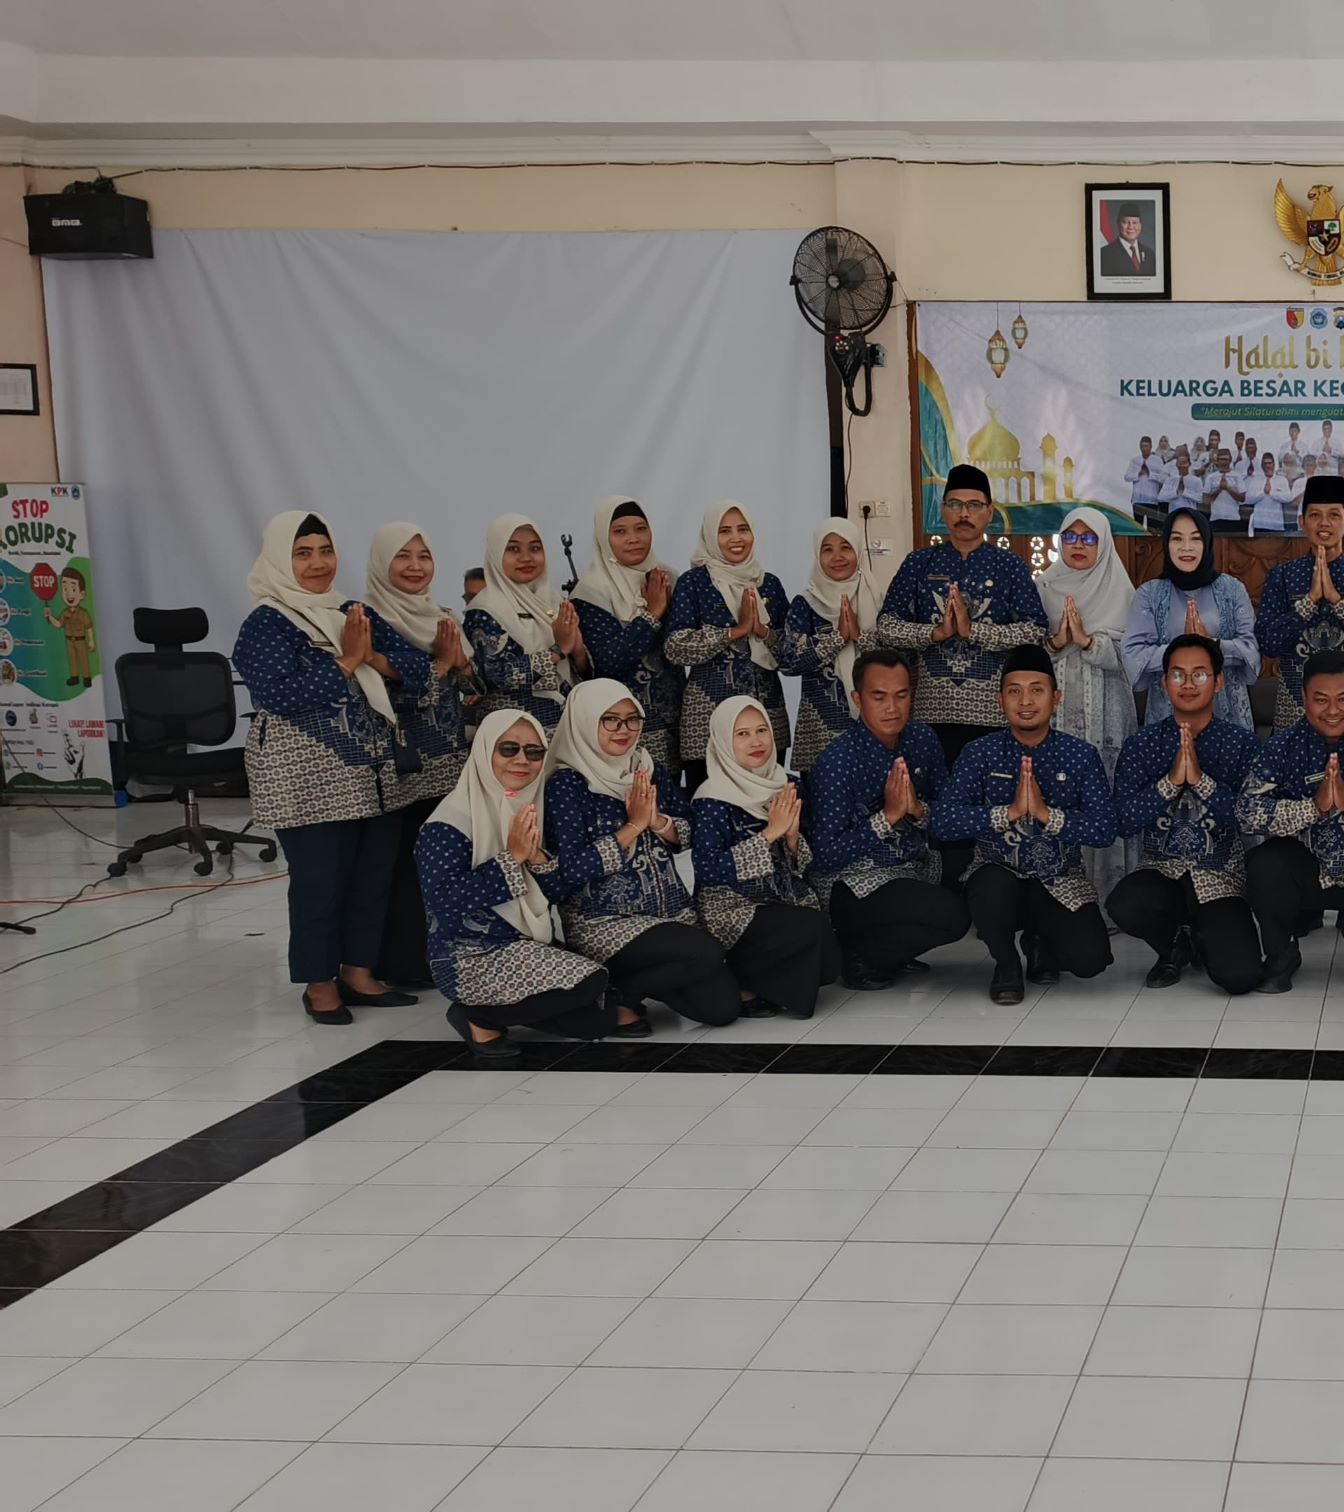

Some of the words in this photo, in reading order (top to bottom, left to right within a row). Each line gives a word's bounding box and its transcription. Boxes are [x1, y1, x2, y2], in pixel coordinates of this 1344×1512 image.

[1223, 335, 1299, 377] Halal
[1305, 335, 1333, 370] bi
[1119, 379, 1234, 398] KELUARGA
[1239, 379, 1307, 398] BESAR
[1243, 407, 1299, 417] Silaturahmi
[50, 486, 69, 496] KPK
[11, 499, 49, 519] STOP
[0, 521, 77, 554] ORUPSI
[33, 575, 55, 588] STOP
